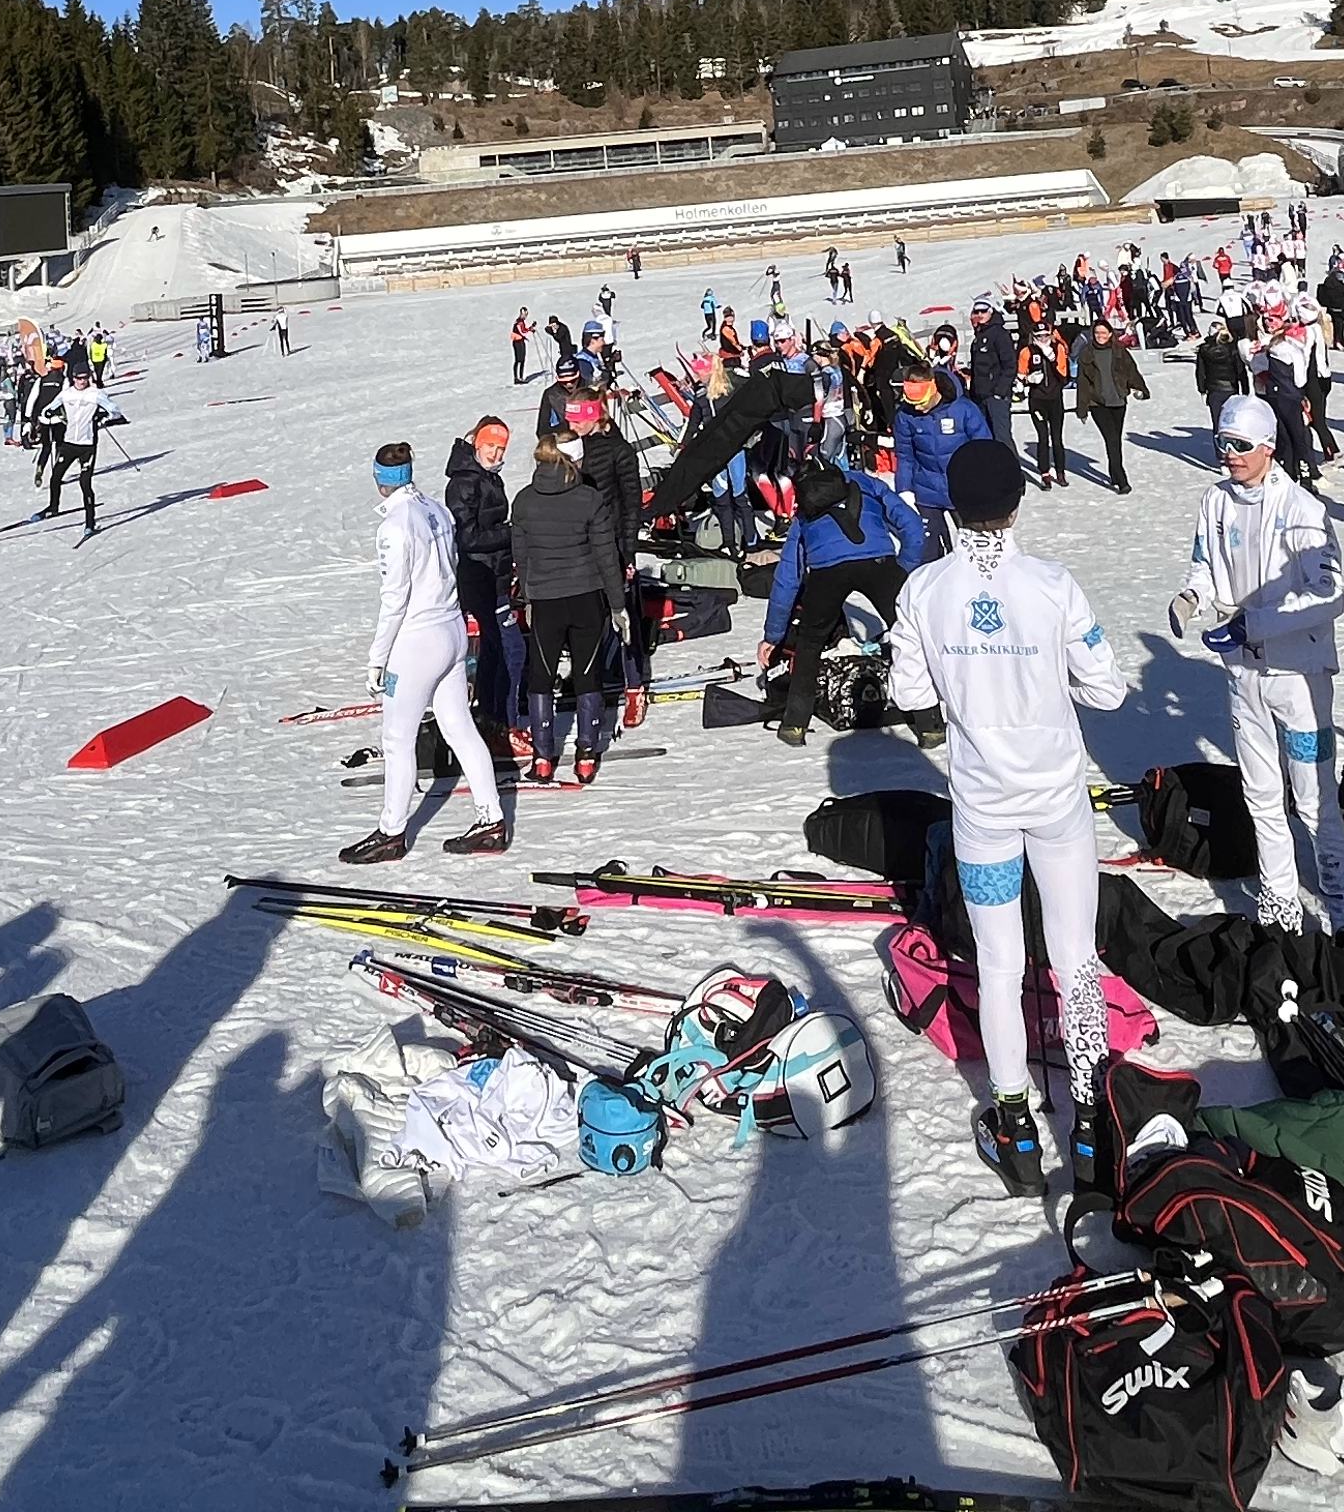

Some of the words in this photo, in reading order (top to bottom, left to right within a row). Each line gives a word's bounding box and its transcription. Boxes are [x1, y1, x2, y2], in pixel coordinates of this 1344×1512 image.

[675, 202, 768, 220] Holmenkollen
[941, 643, 980, 655] ASKER
[980, 642, 1039, 657] SKIKLUBB
[384, 928, 429, 943] FISCHER
